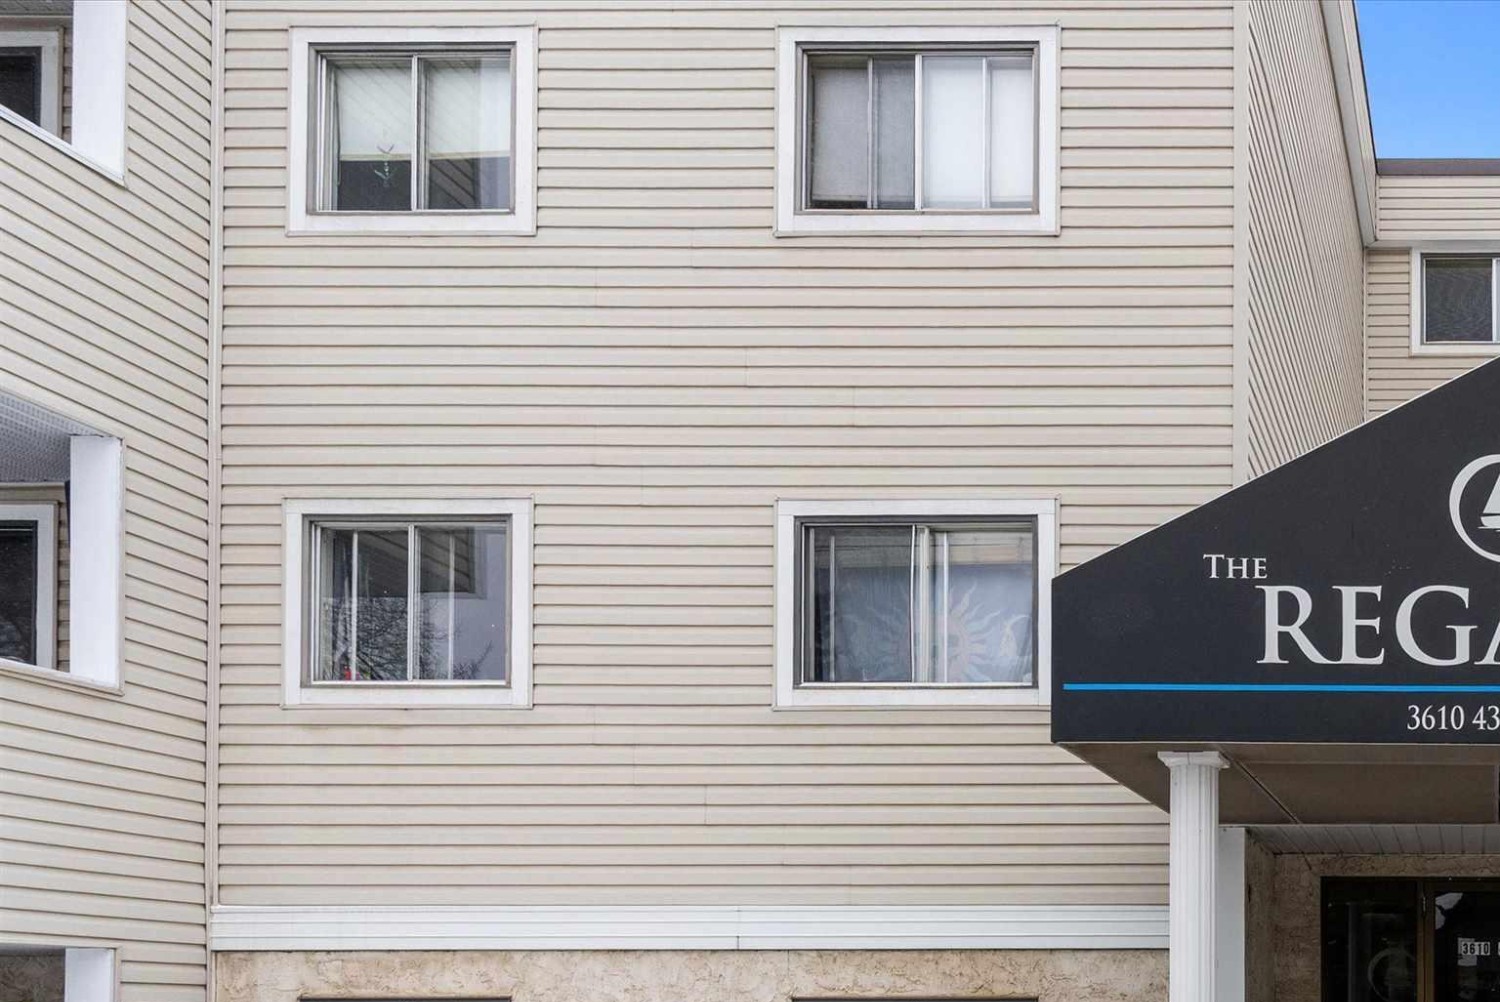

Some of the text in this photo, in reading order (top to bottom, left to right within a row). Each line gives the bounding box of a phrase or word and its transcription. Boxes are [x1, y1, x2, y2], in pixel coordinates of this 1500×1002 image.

[1202, 553, 1268, 579] THE
[1406, 704, 1465, 732] 3610
[1471, 704, 1500, 732] 43
[1461, 942, 1490, 956] 3610
